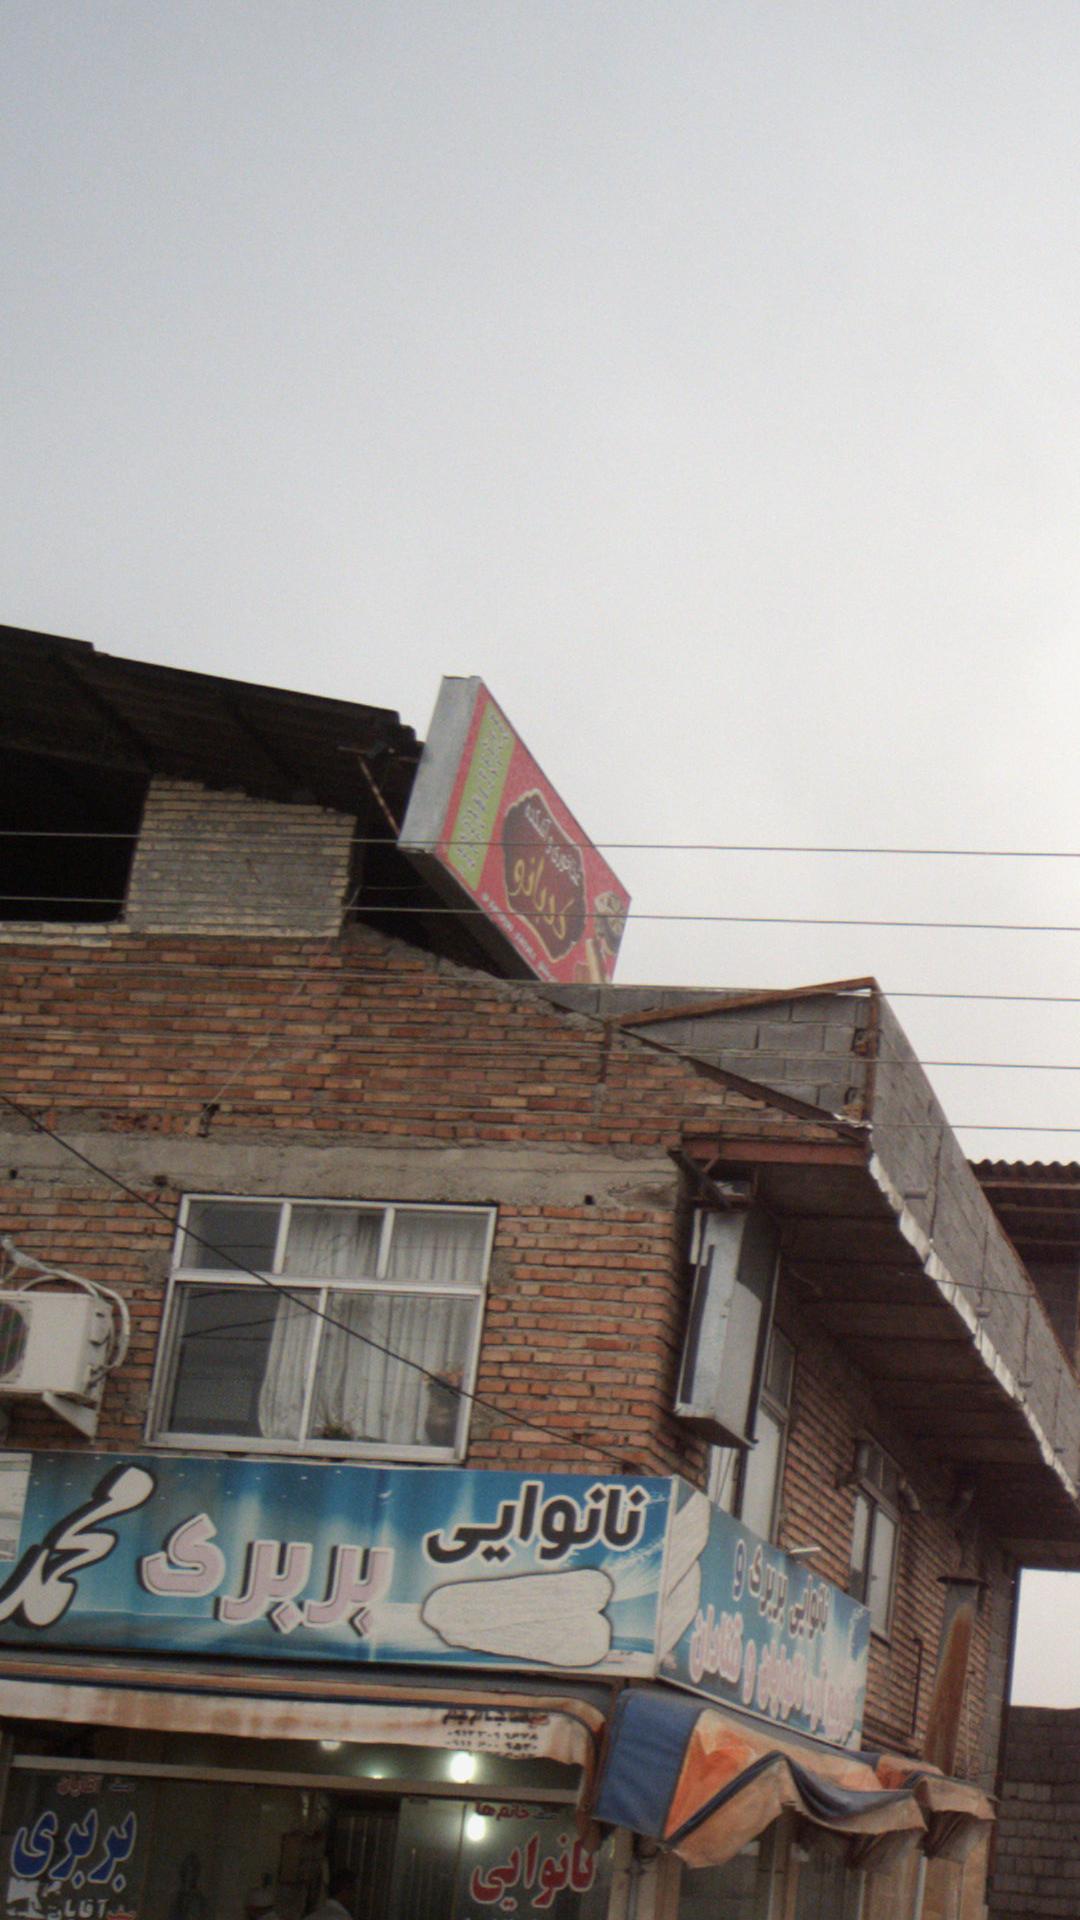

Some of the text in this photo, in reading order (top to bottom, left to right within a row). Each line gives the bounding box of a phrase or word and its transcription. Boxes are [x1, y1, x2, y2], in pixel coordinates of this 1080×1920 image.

[420, 1478, 651, 1567] نانوایی
[138, 1513, 395, 1637] بربری
[749, 1544, 789, 1625] بربری
[10, 1808, 137, 1893] بربری
